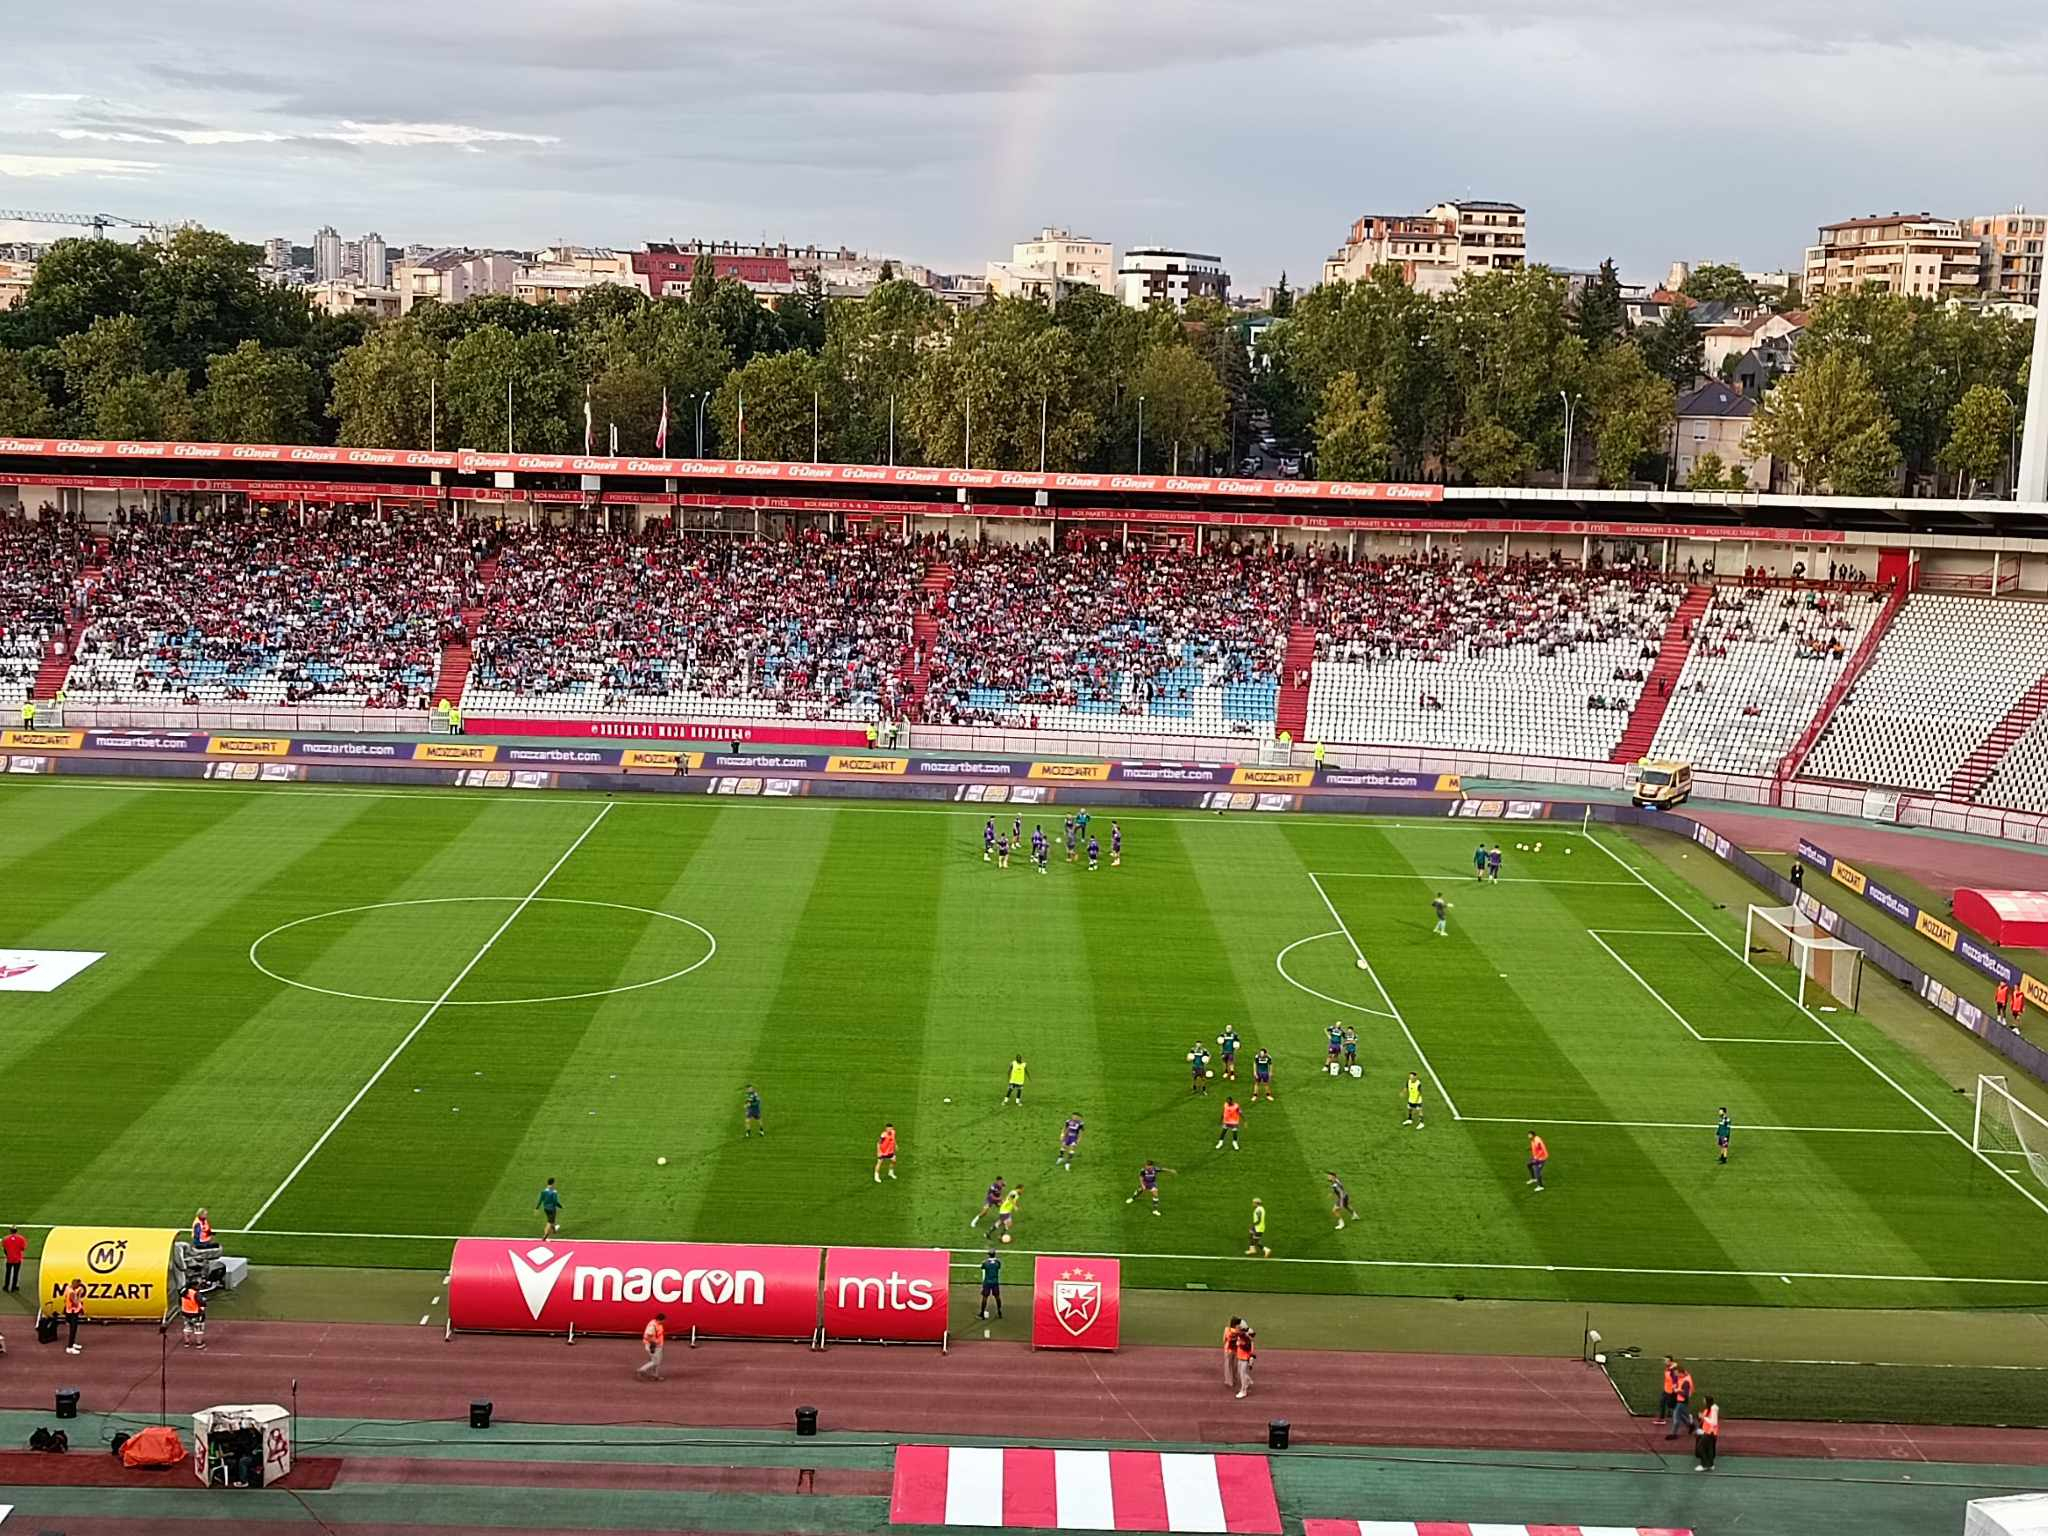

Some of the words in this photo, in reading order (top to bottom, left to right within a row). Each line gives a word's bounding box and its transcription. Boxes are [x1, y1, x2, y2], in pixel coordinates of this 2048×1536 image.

[771, 498, 788, 506] mts
[1308, 518, 1328, 526] mts
[1590, 524, 1609, 532] mts
[12, 734, 70, 745] MOZZART
[96, 735, 188, 749] mozzartbet.com
[219, 741, 278, 752] MOZZART
[303, 743, 395, 756] mozzartbet.com
[426, 747, 484, 758] MOZZART
[510, 749, 601, 761] mozzartbet.com
[716, 756, 808, 768] mozzartbet.com
[839, 760, 896, 771] MOZZART
[920, 762, 1010, 774] mozzartbet.com
[1041, 766, 1099, 777] MOZZART
[1123, 768, 1212, 780] mozzartbet.com
[1244, 772, 1302, 783] MOZZART
[1326, 774, 1418, 786] mozzartbet.com
[1836, 864, 1861, 890] MOZZART
[1869, 884, 1910, 920] mozzartbet.com
[1922, 917, 1953, 943] MOZZART
[1961, 941, 2011, 981] mozzartbet.com
[572, 1264, 766, 1306] macron
[837, 1270, 934, 1312] mts
